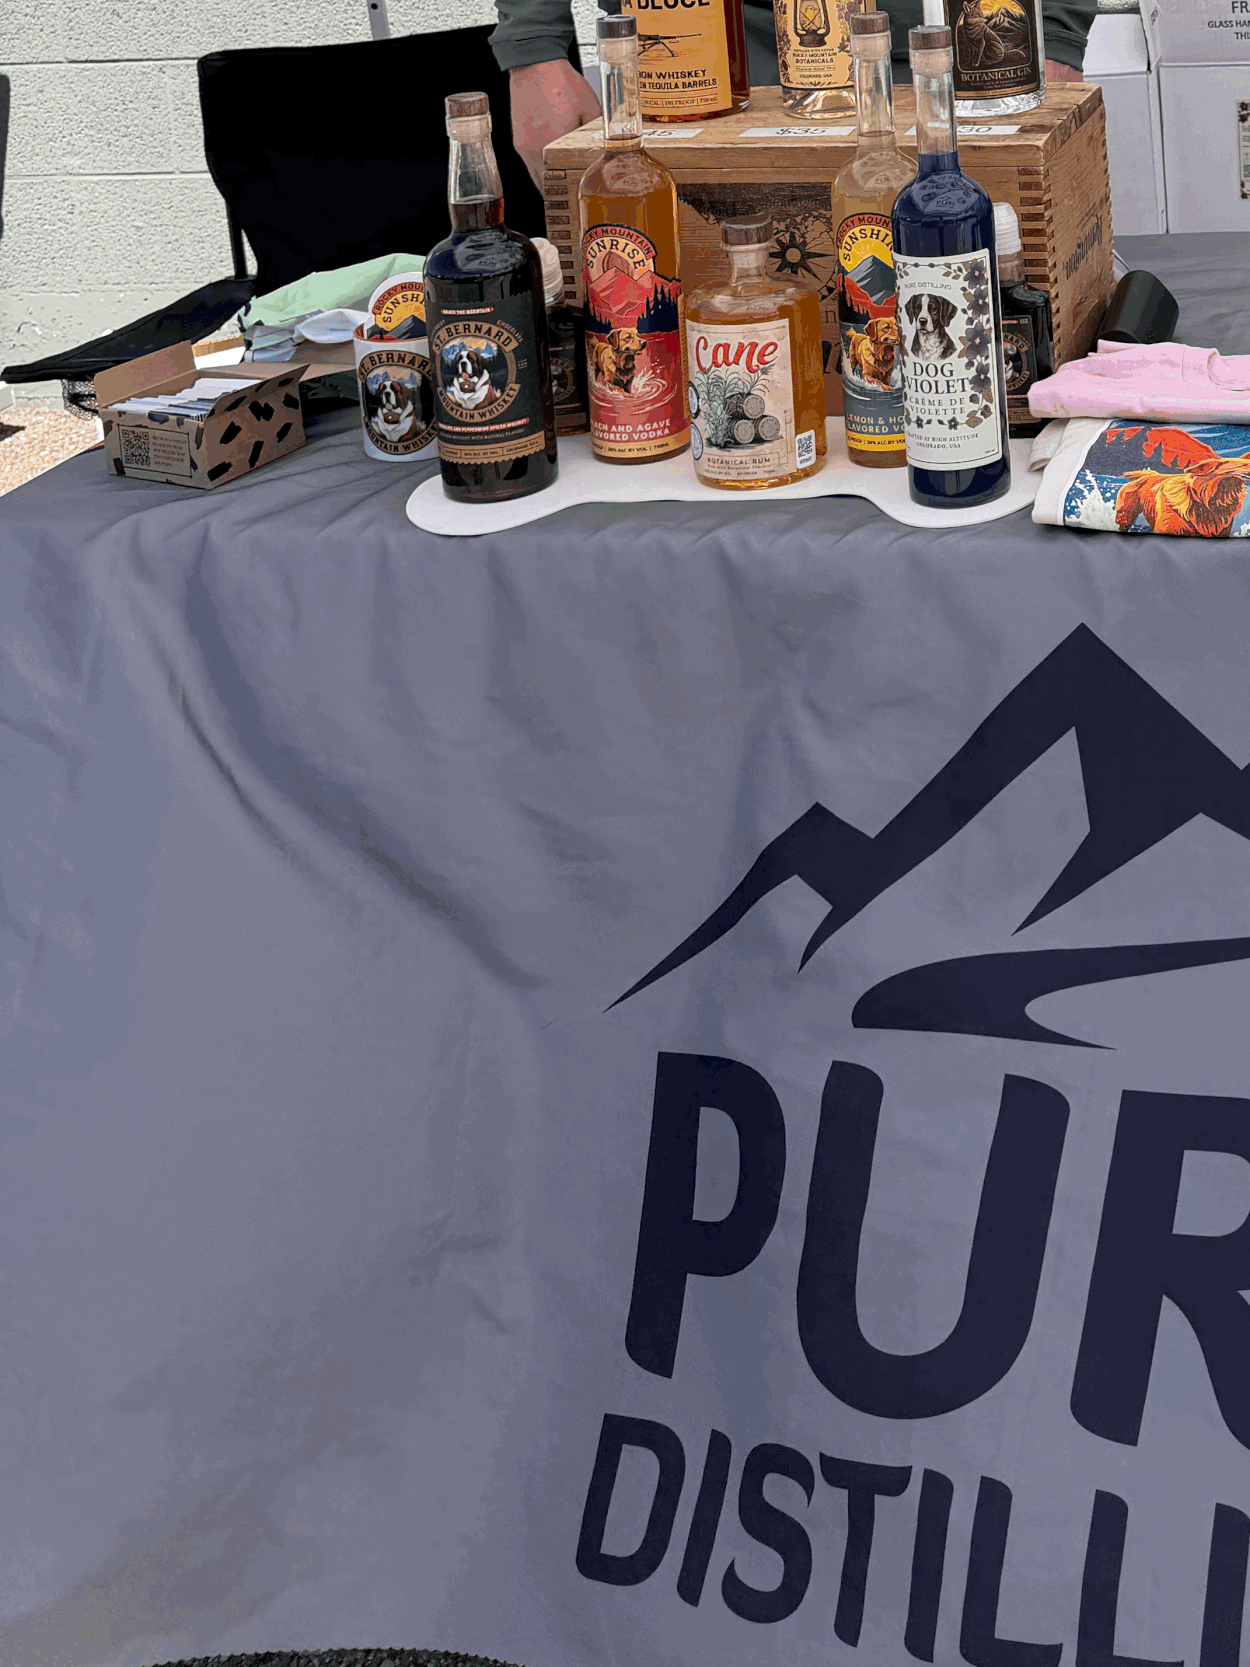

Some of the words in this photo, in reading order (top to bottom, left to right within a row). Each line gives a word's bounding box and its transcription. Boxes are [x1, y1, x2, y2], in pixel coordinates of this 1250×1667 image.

[1207, 20, 1234, 29] GLASS
[655, 69, 707, 81] WHISKEY
[961, 69, 1017, 82] BOTANICAL
[648, 81, 680, 91] TEQUILA
[682, 78, 718, 90] BARRELS
[776, 127, 826, 136] $35
[857, 216, 891, 227] MOUN
[601, 228, 652, 255] MOUNTAIN
[843, 228, 893, 262] SUNSHI
[586, 238, 646, 269] SUNRISE
[917, 281, 952, 291] DISTILLING
[374, 287, 398, 311] ROCKY
[382, 293, 425, 323] SUNSH
[433, 334, 447, 351] ST.
[446, 323, 513, 348] BERNARD
[696, 335, 778, 373] Cane
[913, 362, 955, 378] DOG
[905, 377, 970, 394] VIOLET
[439, 387, 475, 421] MOUNTAIN
[478, 386, 518, 419] WHISKEY
[949, 397, 965, 406] DE
[910, 405, 966, 416] VIOLETTE
[611, 425, 633, 433] AND
[636, 418, 671, 432] AGAVE
[594, 430, 629, 441] AVORED
[632, 428, 670, 440] VODKA
[948, 432, 979, 442] ALTITUDE
[707, 457, 749, 465] BOTANICAL
[752, 457, 771, 465] RUM
